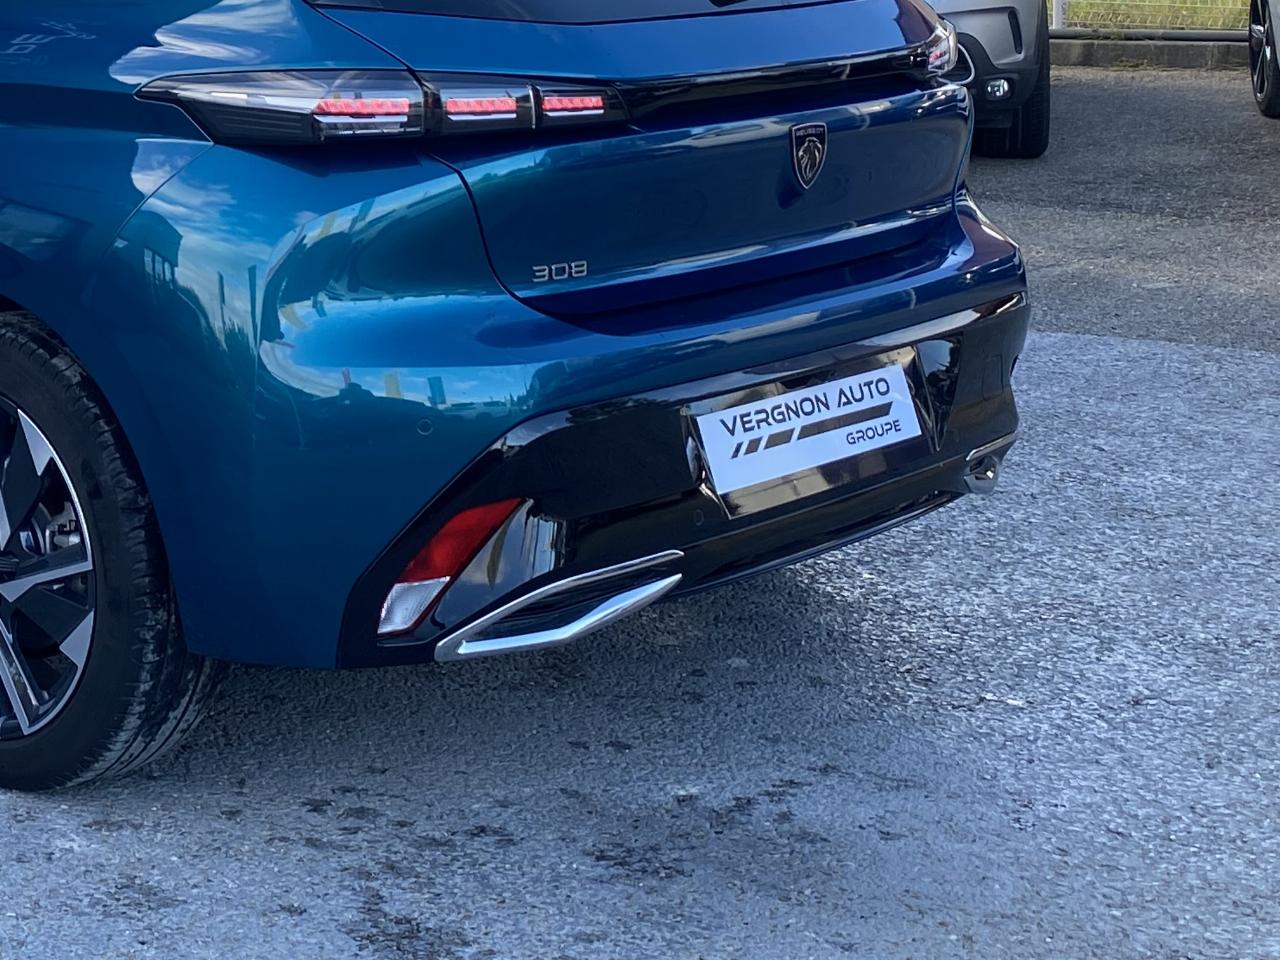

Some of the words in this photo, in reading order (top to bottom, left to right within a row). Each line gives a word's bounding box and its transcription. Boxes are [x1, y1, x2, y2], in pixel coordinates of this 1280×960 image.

[531, 260, 588, 283] 308
[720, 392, 831, 437] VERGNON
[837, 377, 891, 408] AUTO
[846, 419, 902, 445] GROUPE
